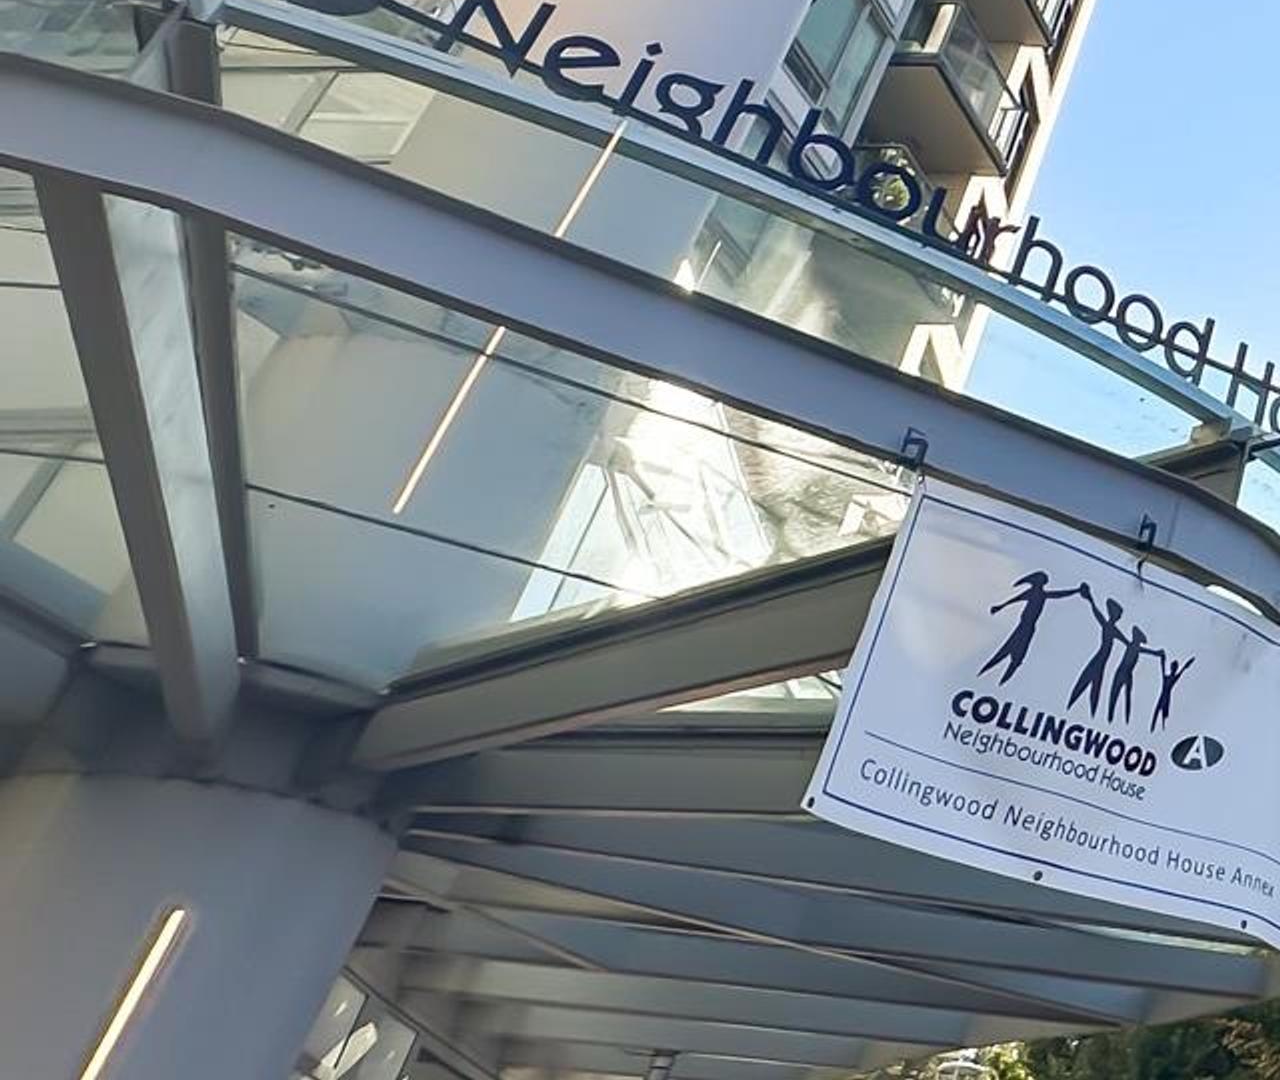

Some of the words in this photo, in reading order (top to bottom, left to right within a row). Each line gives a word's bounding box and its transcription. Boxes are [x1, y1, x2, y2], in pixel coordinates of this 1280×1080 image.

[943, 721, 1099, 784] Neighbourhood
[1099, 769, 1146, 801] House
[951, 690, 1157, 777] COLLINGWOOD
[859, 758, 999, 821] Collingwood
[1003, 804, 1160, 866] Neighbourhood
[1165, 850, 1227, 882] House
[1230, 866, 1276, 898] Annex
